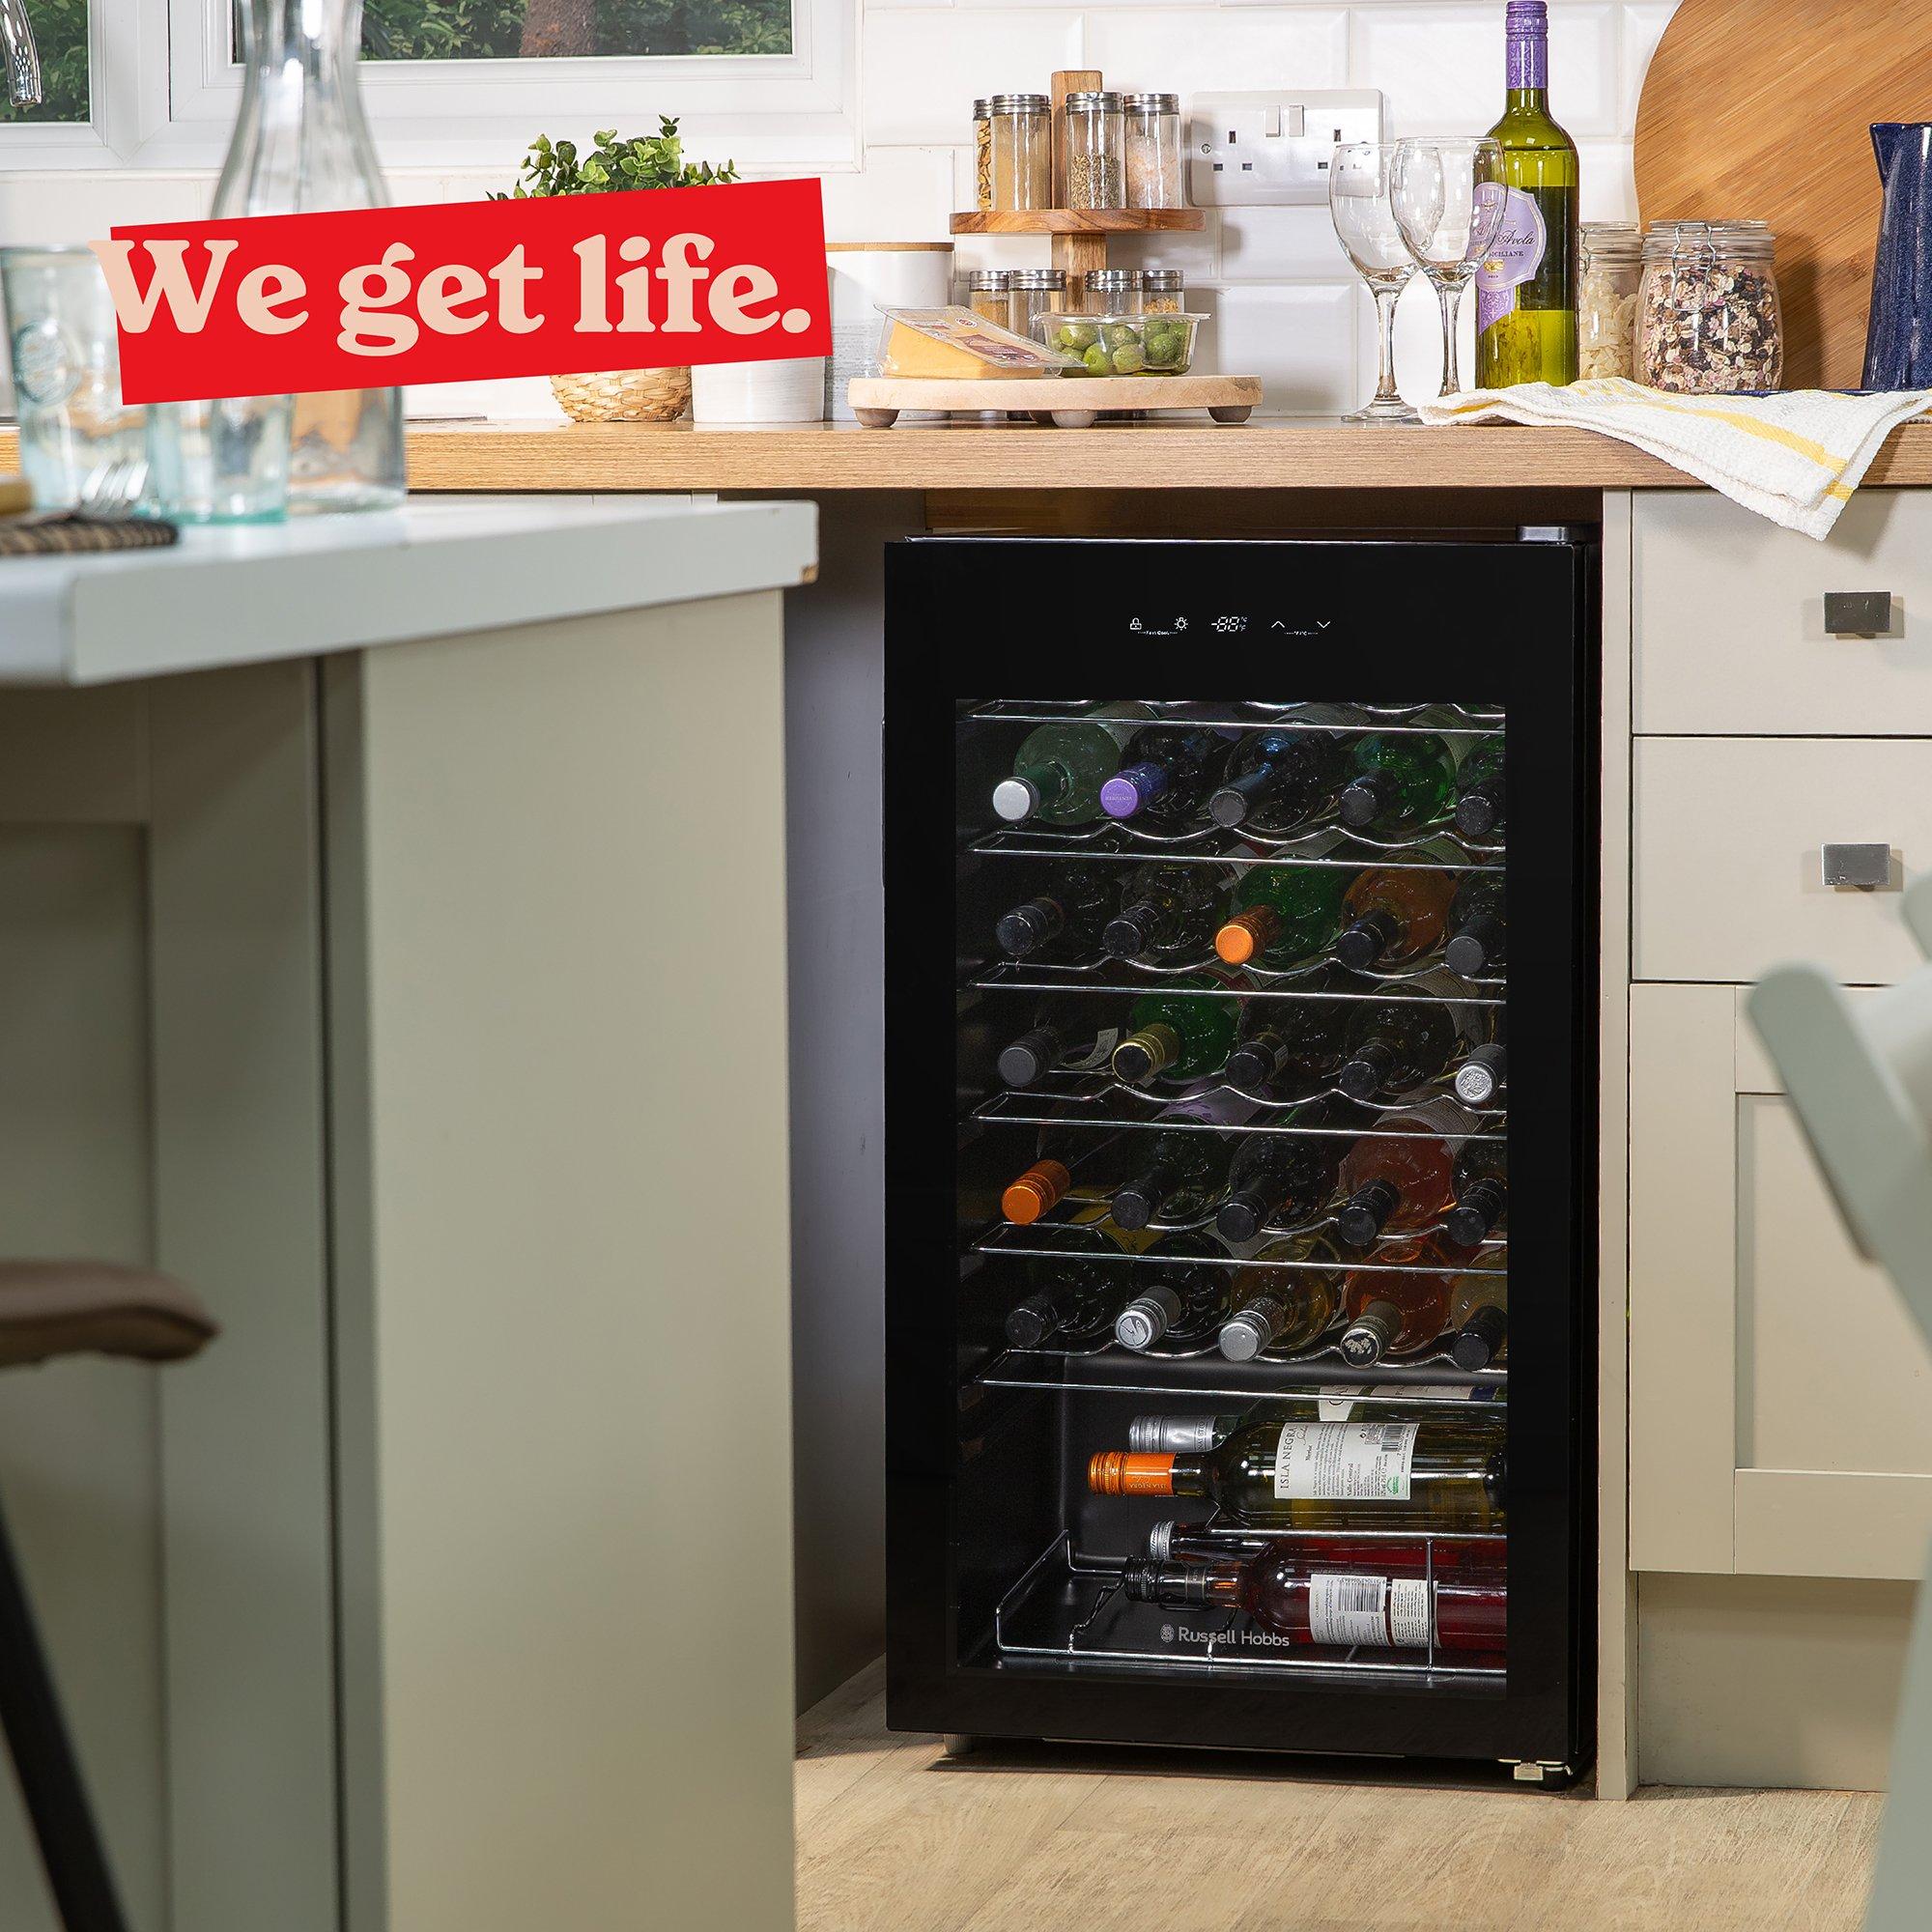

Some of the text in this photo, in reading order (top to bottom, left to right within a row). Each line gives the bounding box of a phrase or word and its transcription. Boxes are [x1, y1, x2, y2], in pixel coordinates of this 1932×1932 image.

[1280, 1425, 1298, 1489] ISLA NEGRA
[1178, 1626, 1291, 1647] Russell Hobbs
